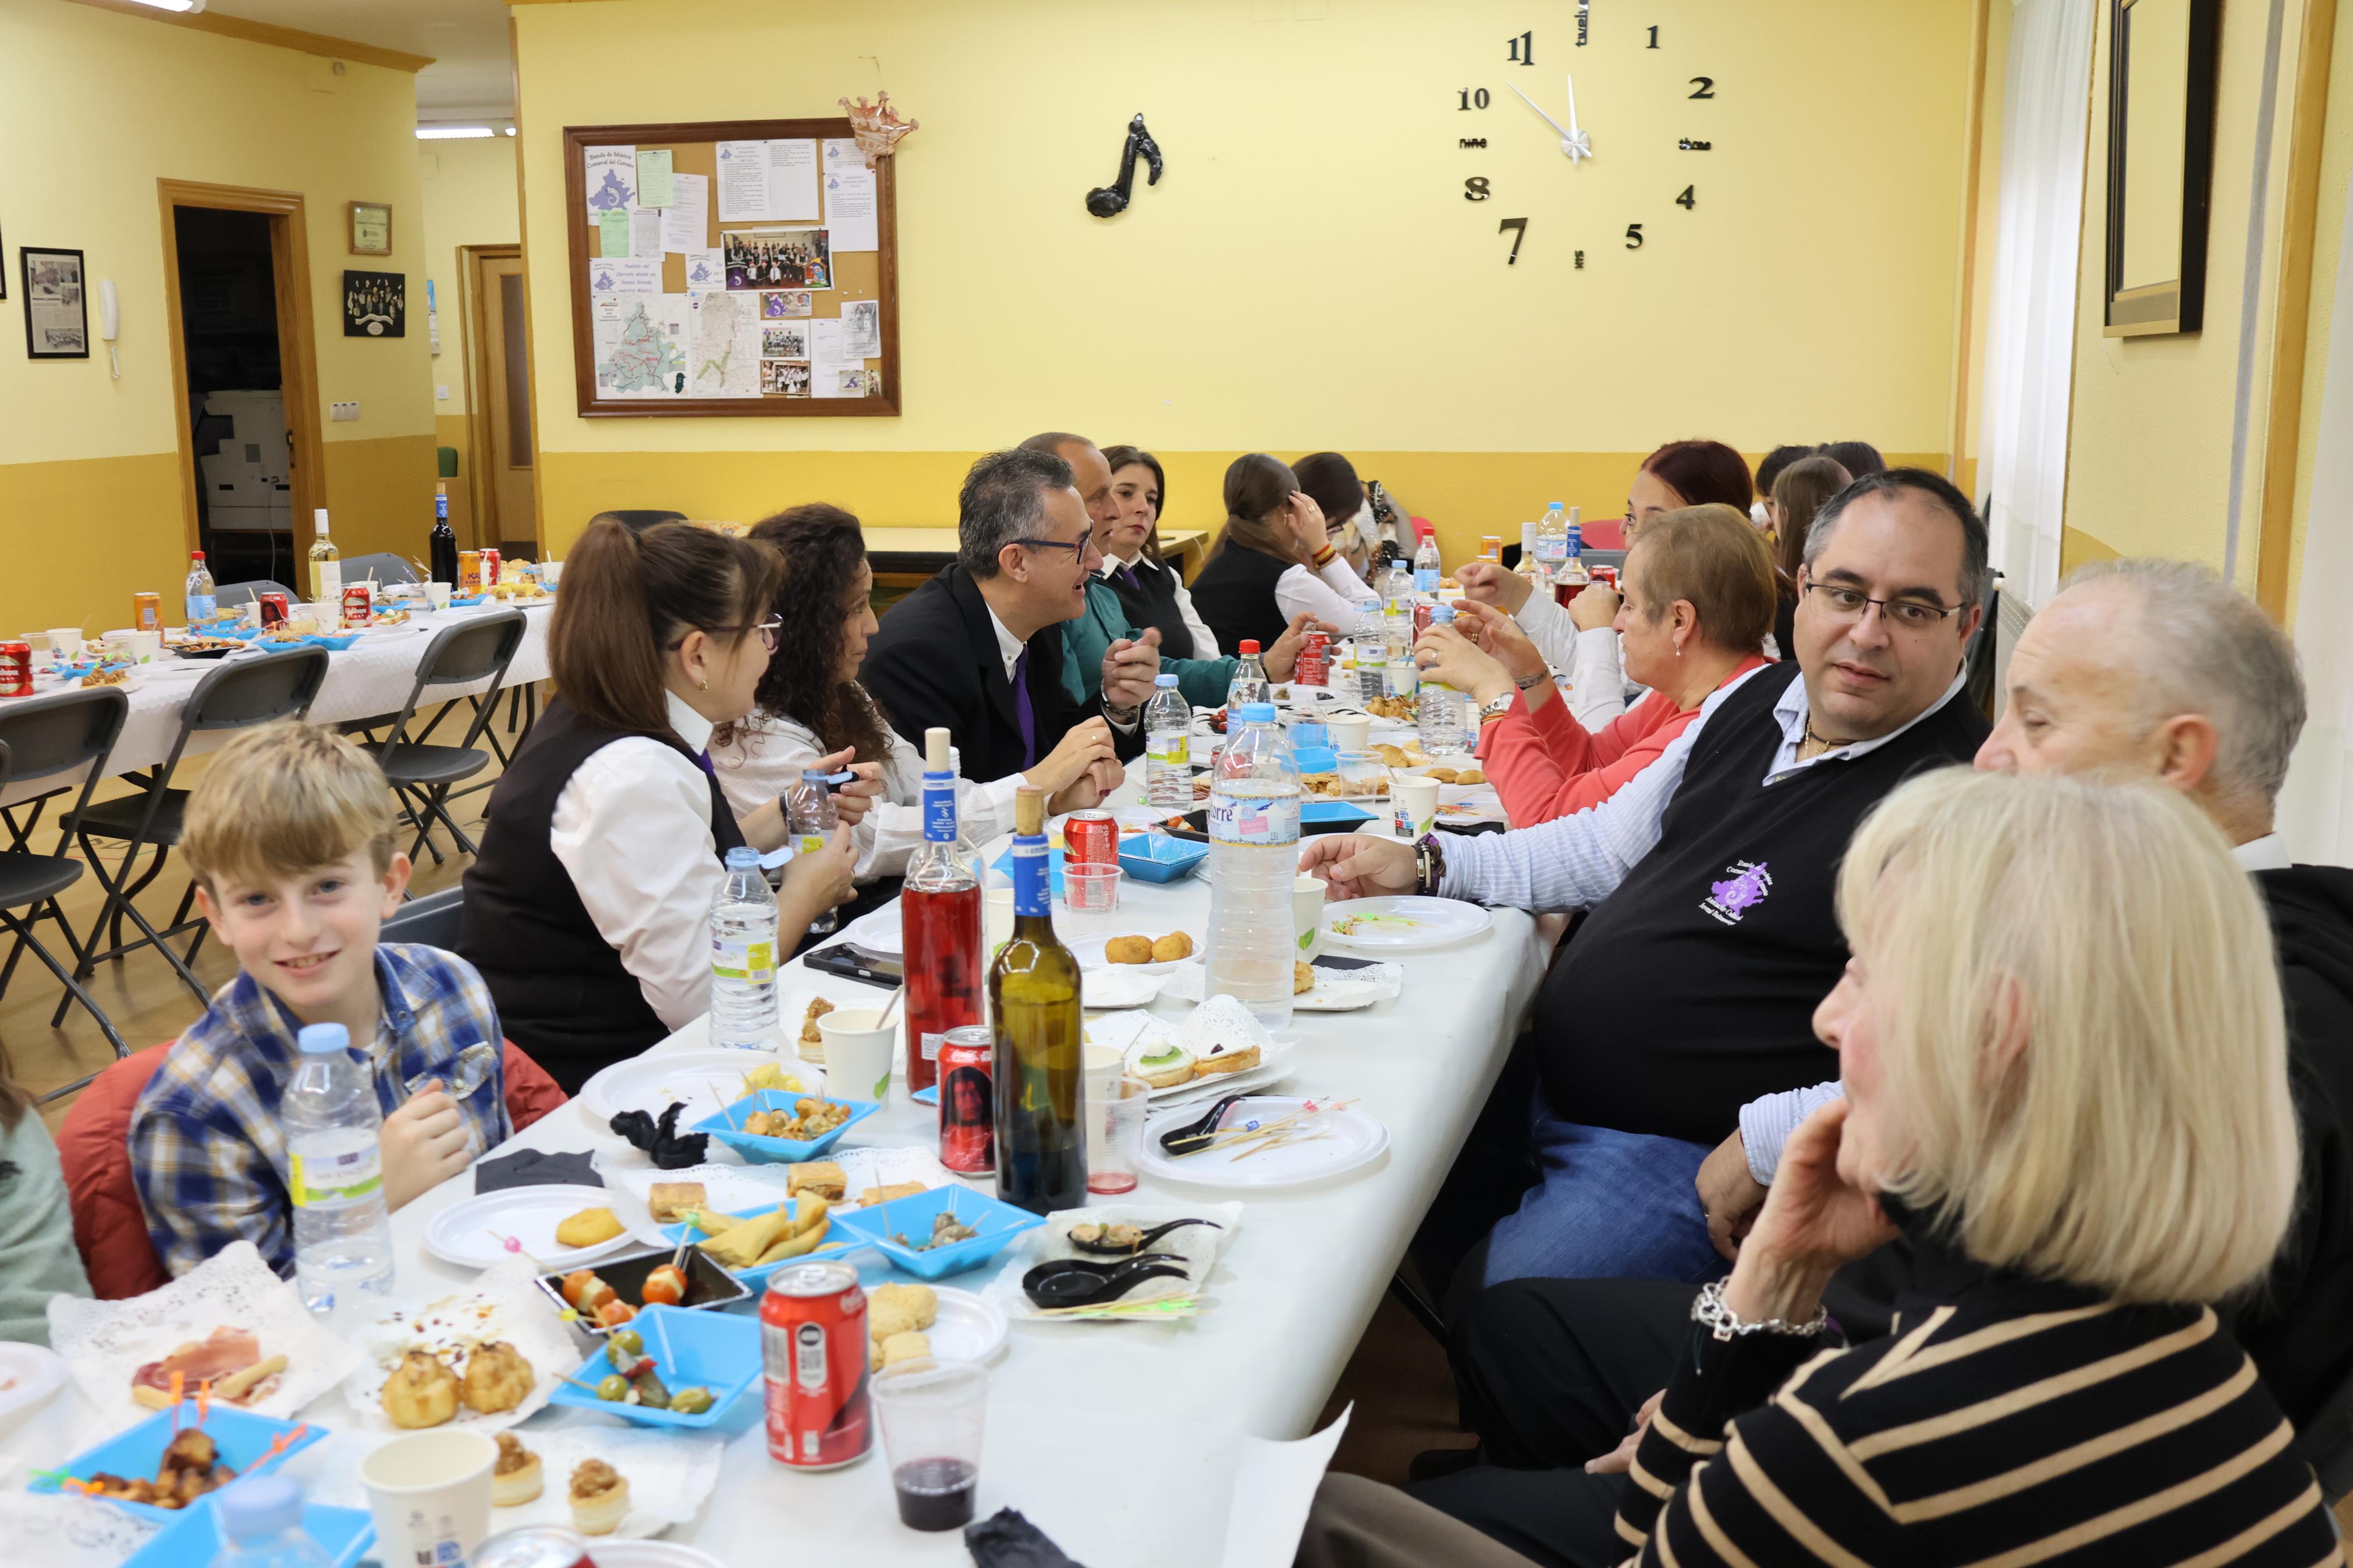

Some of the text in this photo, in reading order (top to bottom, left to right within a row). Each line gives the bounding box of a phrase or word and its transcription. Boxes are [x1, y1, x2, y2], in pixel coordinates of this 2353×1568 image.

[1507, 30, 1535, 66] 11
[1646, 25, 1661, 49] 1
[1458, 88, 1489, 111] 10
[1688, 77, 1715, 99] 2
[1460, 138, 1487, 148] nine
[1464, 177, 1490, 201] 8
[1676, 184, 1695, 209] 4
[1499, 218, 1528, 265] 7
[1626, 224, 1643, 249] 5
